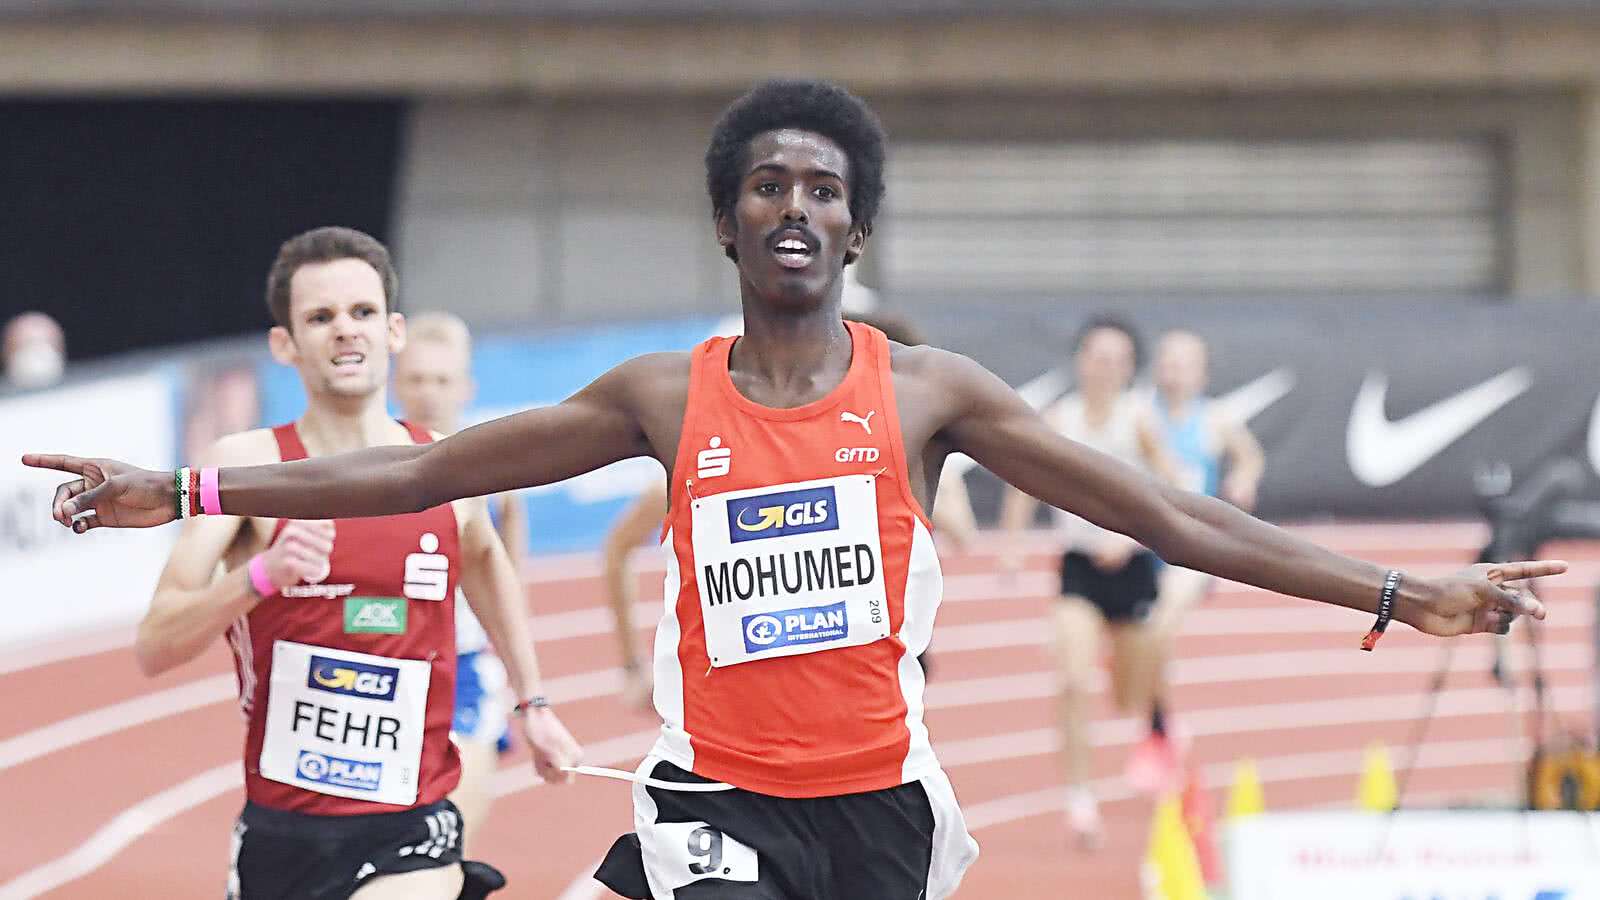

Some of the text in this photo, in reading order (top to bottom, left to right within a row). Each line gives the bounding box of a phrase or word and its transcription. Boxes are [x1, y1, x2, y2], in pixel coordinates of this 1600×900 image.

[784, 499, 828, 526] GLS
[704, 543, 875, 607] MOHUMED
[785, 610, 844, 633] PLAN
[868, 600, 882, 624] 209
[787, 629, 844, 641] INTERNATIONAL
[355, 671, 394, 695] GLS
[292, 700, 401, 751] FEHR
